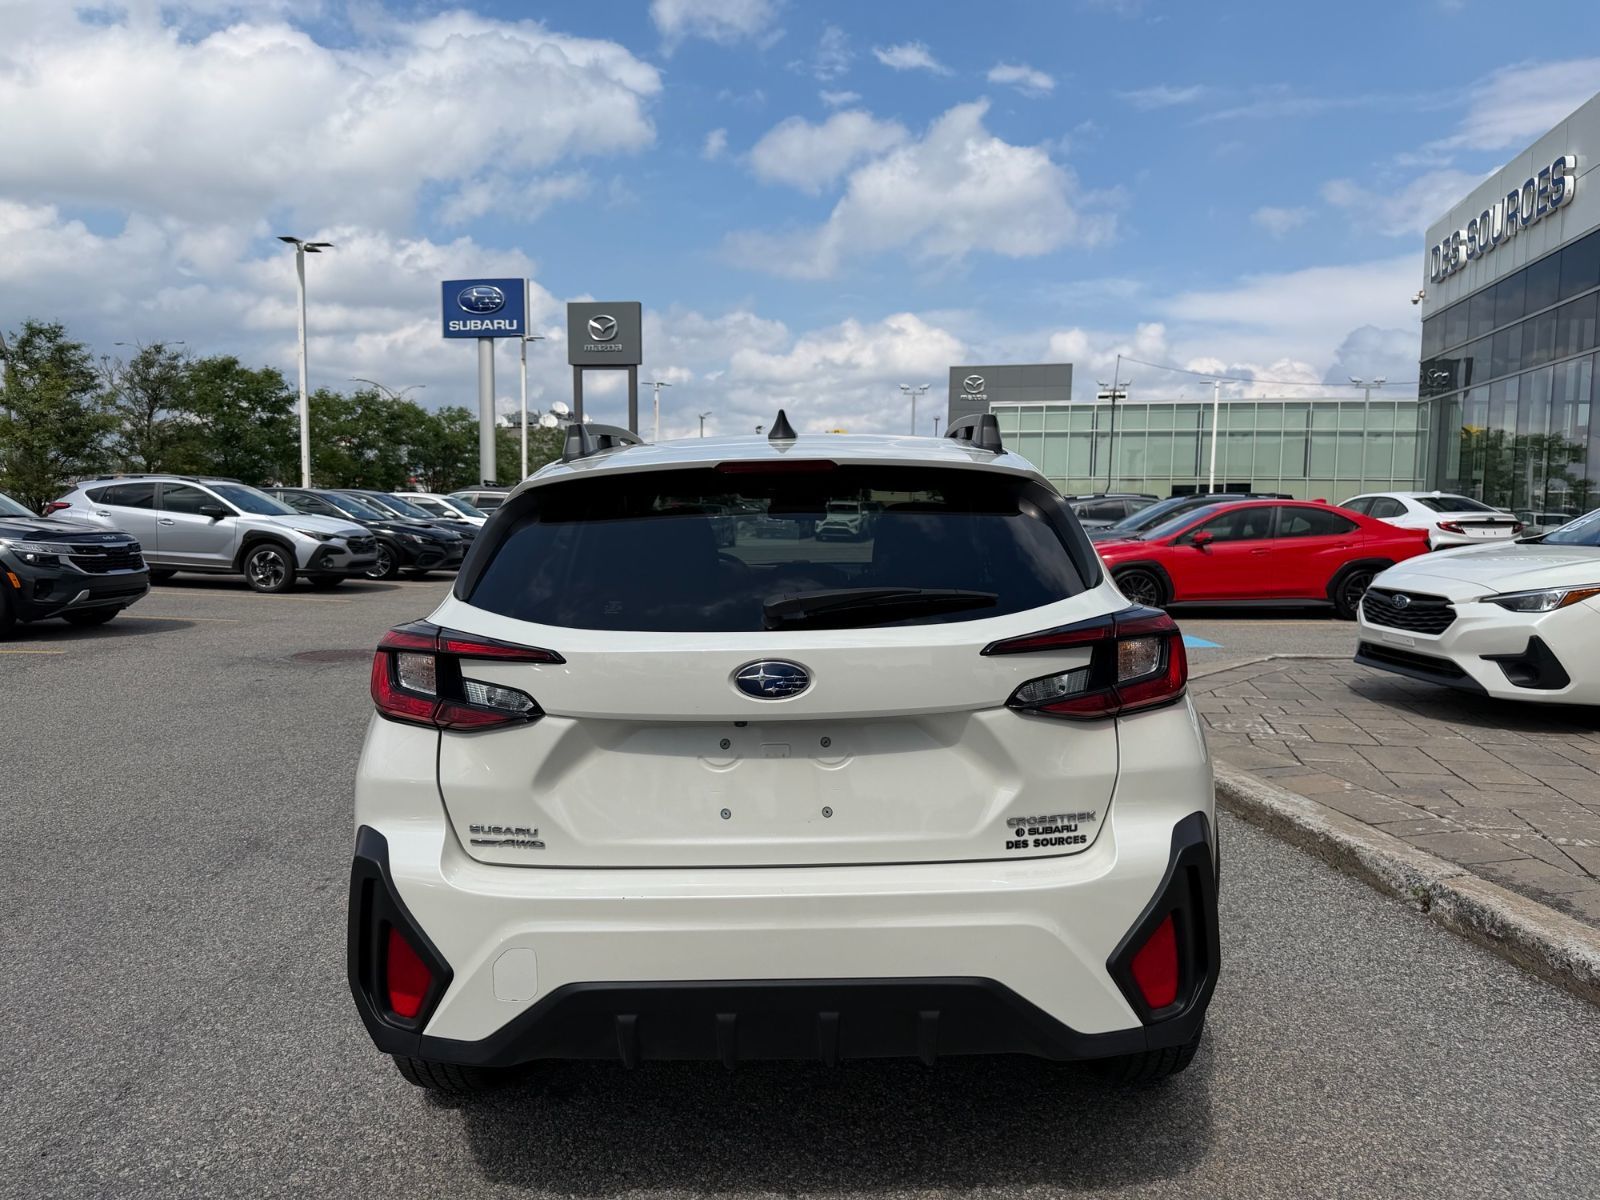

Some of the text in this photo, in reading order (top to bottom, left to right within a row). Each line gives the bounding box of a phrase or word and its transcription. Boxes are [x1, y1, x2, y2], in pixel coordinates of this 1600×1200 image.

[1430, 229, 1468, 284] DES
[449, 319, 518, 331] SUBARU
[1006, 810, 1096, 828] CROSSTREK
[469, 825, 538, 838] SUBARU
[1027, 824, 1078, 836] SUBARU
[1005, 834, 1087, 850] DES SOURCES
